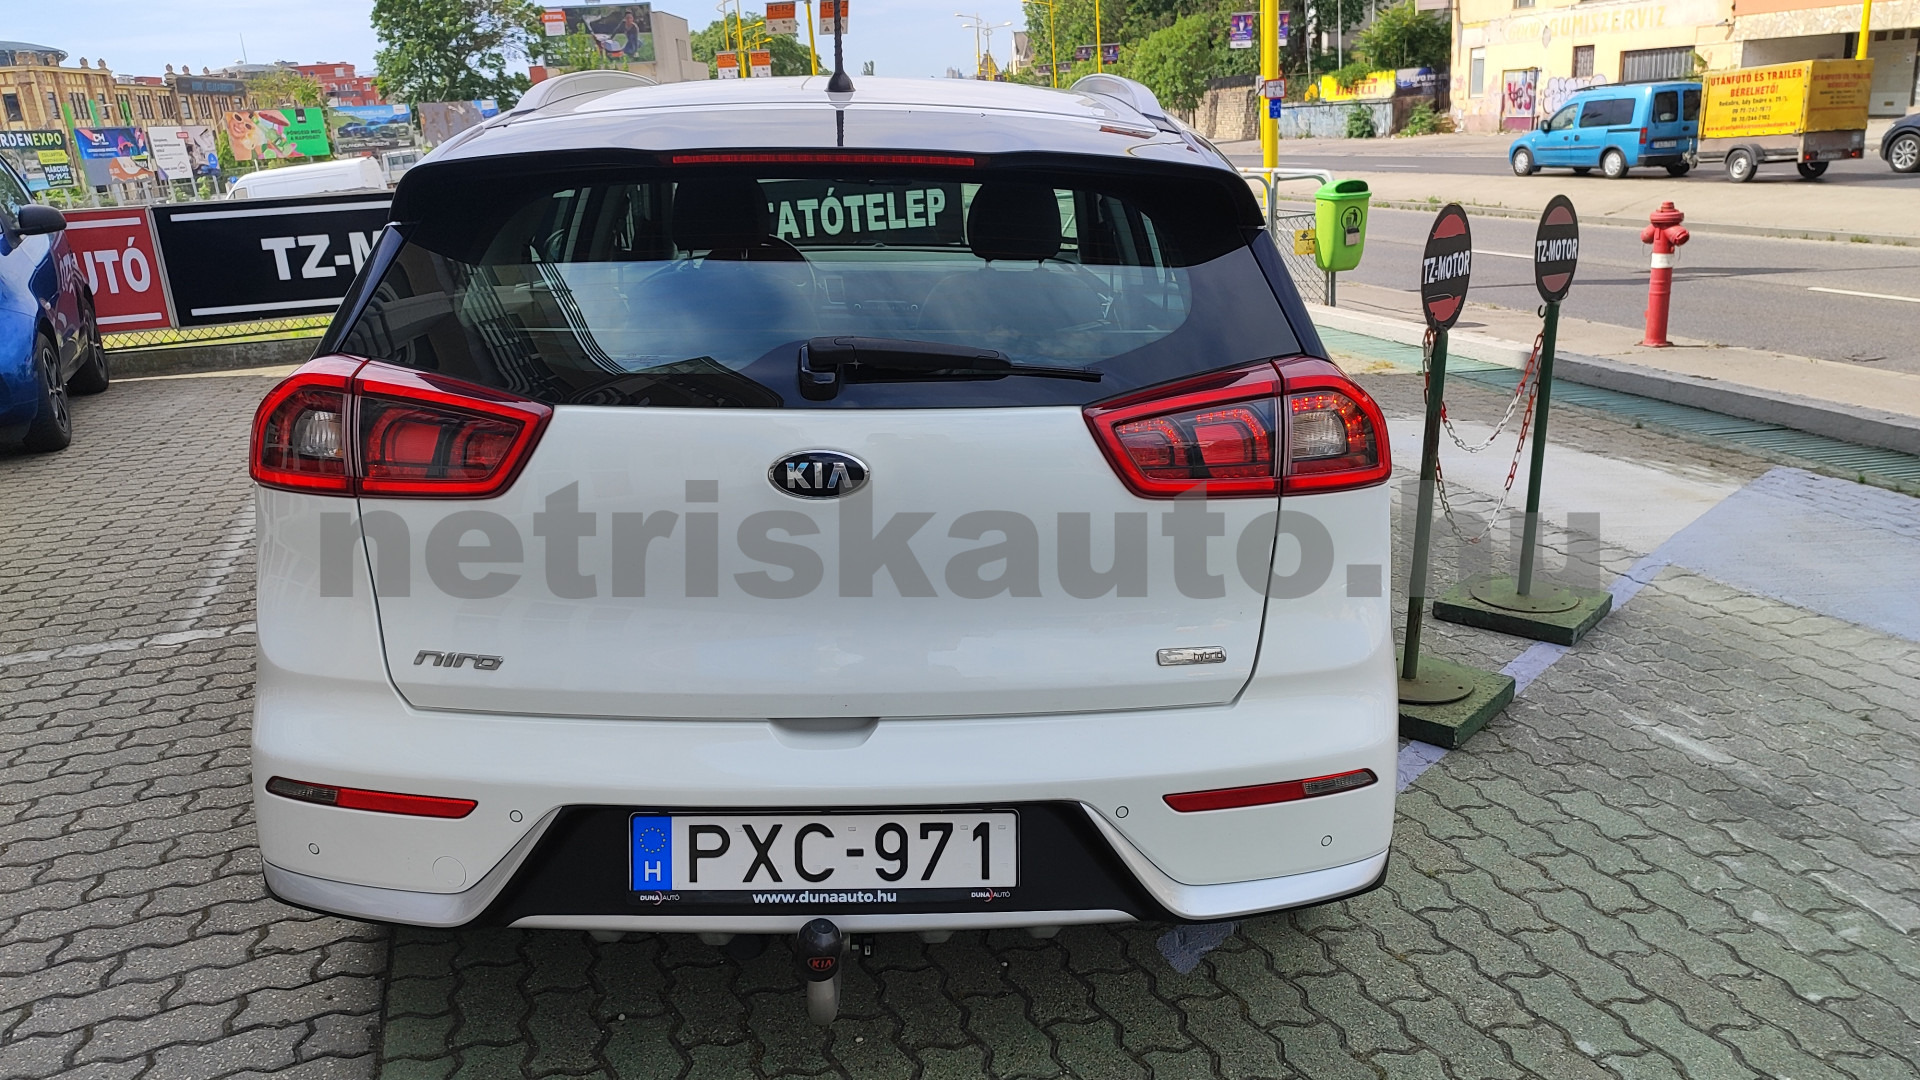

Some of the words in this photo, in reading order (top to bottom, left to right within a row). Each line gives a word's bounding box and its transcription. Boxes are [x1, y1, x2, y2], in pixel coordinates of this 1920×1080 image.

[767, 3, 794, 11] HERZ
[821, 1, 848, 10] HEZ
[1550, 6, 1667, 37] GUMISZERVIZ
[1710, 73, 1752, 86] UTÁNFUTÓ
[1754, 71, 1765, 82] ÉS
[1767, 68, 1802, 80] TRAILER
[0, 132, 62, 147] RDENEXPO
[1536, 238, 1578, 263] TZ-MOTOR
[1423, 250, 1470, 285] TZ-MOTOR
[785, 462, 853, 489] KIA
[413, 649, 504, 670] niro
[1193, 650, 1223, 661] hybrid
[644, 860, 662, 882] H
[688, 822, 990, 883] PXC-971
[662, 893, 680, 901] AUTÓ
[752, 890, 897, 904] www.dunaauto.hu
[992, 890, 1011, 898] AUTÓ
[812, 959, 832, 968] KIA
